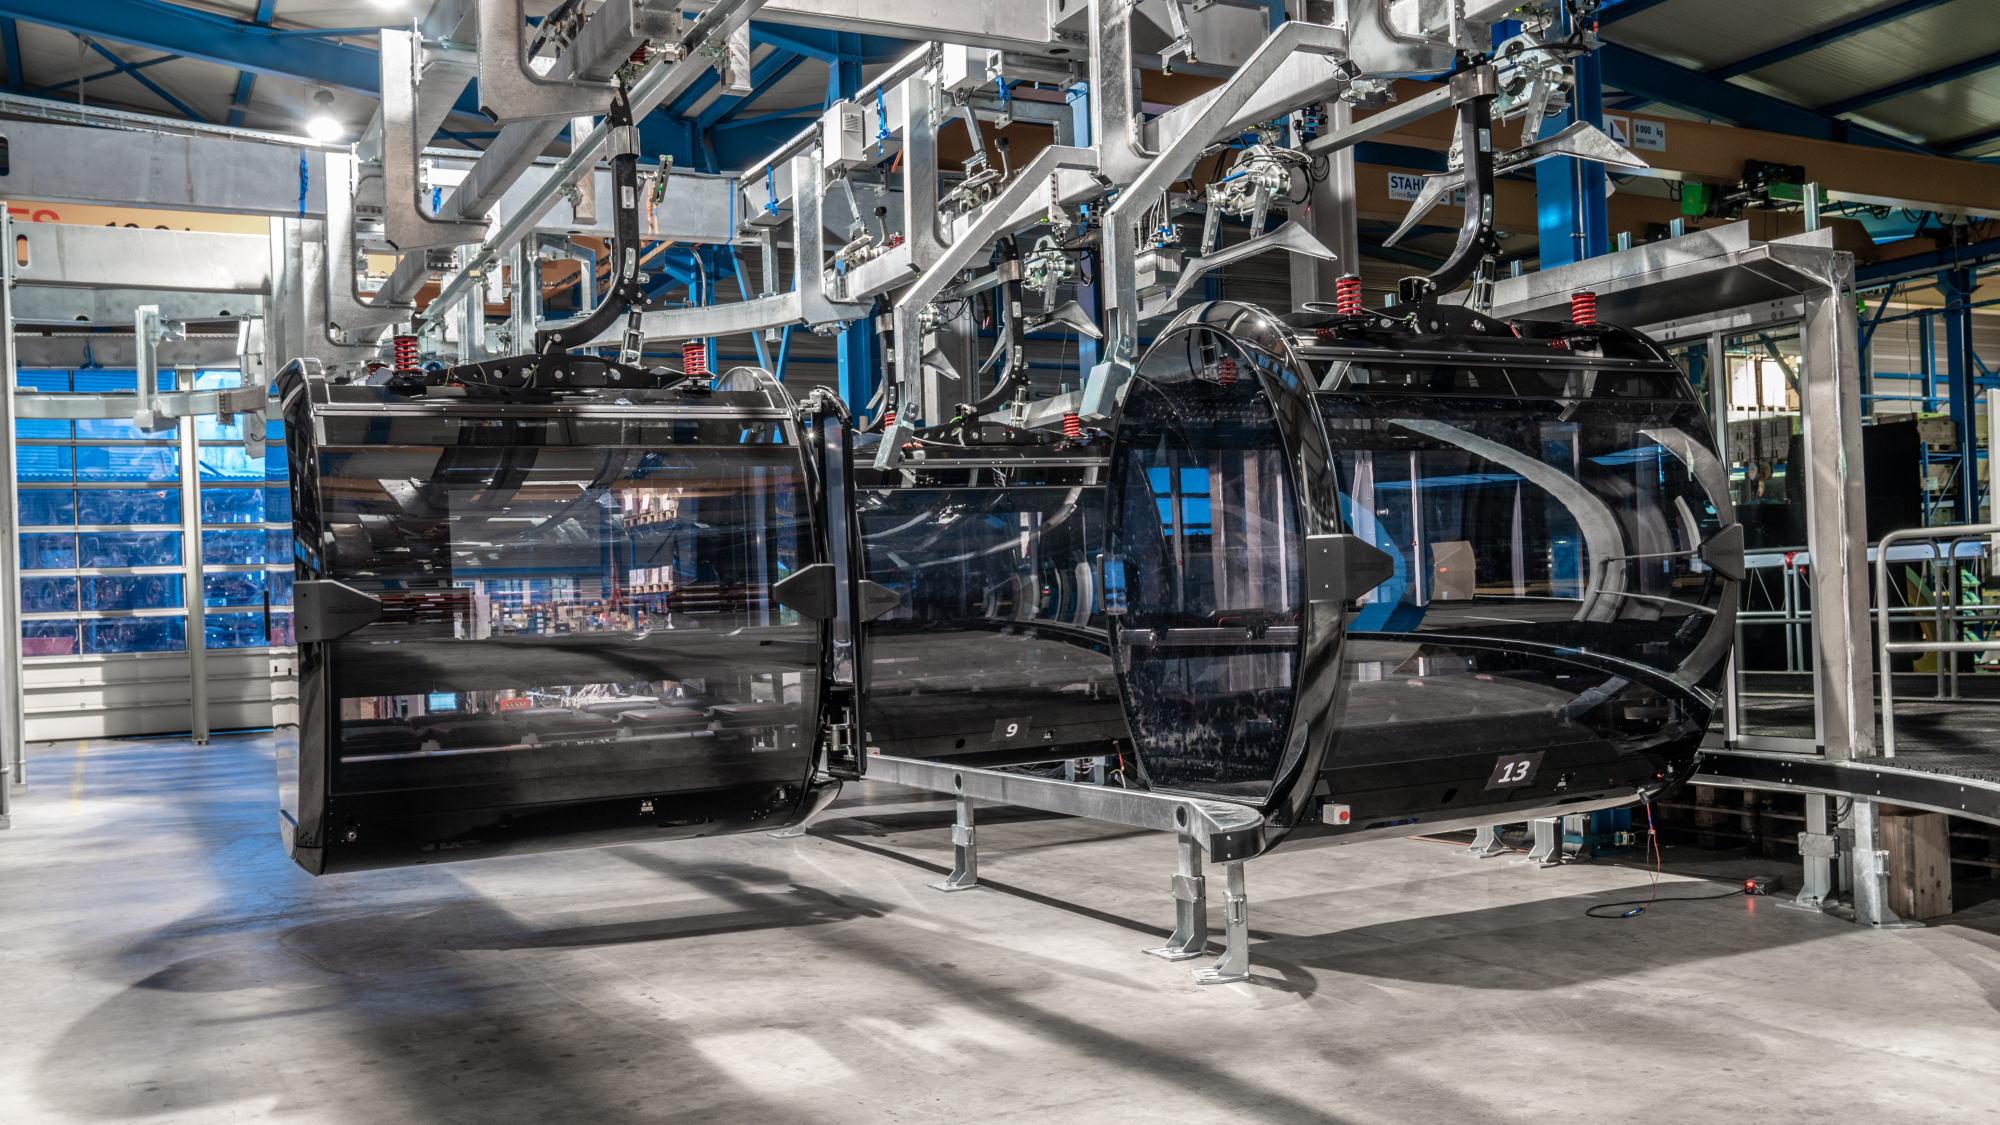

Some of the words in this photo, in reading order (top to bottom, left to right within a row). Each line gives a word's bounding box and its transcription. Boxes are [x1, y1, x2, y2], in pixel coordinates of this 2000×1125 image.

[1656, 127, 1664, 138] kg
[1391, 190, 1418, 200] CraneSyst
[1005, 723, 1019, 738] 9
[1497, 760, 1531, 784] 13
